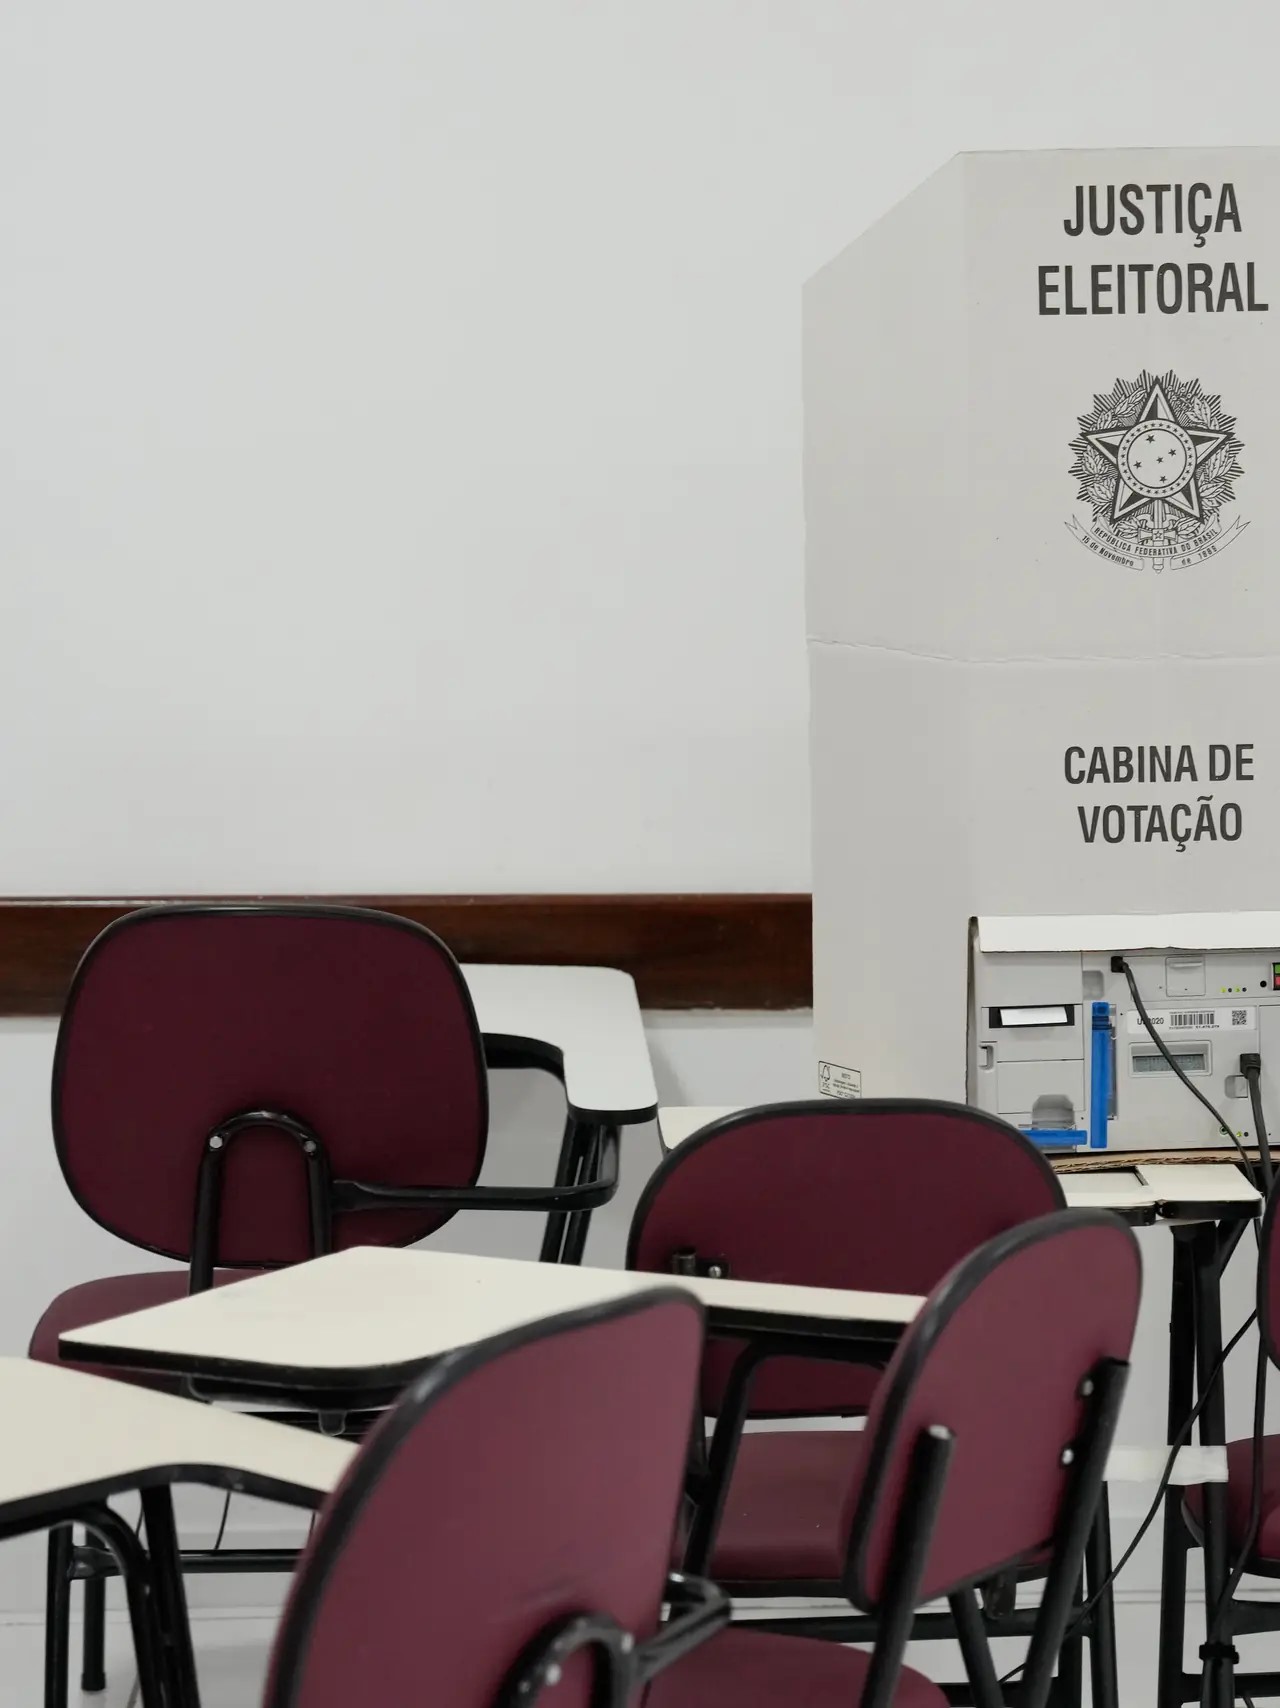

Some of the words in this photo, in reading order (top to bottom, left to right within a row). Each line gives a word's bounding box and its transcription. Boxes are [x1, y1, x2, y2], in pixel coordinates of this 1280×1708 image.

[1064, 182, 1242, 248] JUSTIÇA
[1038, 262, 1269, 316] ELEITORAL
[1099, 547, 1134, 566] Novembro
[1134, 546, 1178, 556] FEDERATIVA
[1181, 542, 1191, 552] DO
[1193, 529, 1218, 547] BRASIL
[1064, 744, 1199, 785] CABINA
[1208, 743, 1255, 782] DE
[1077, 794, 1243, 853] VOTAÇÃO
